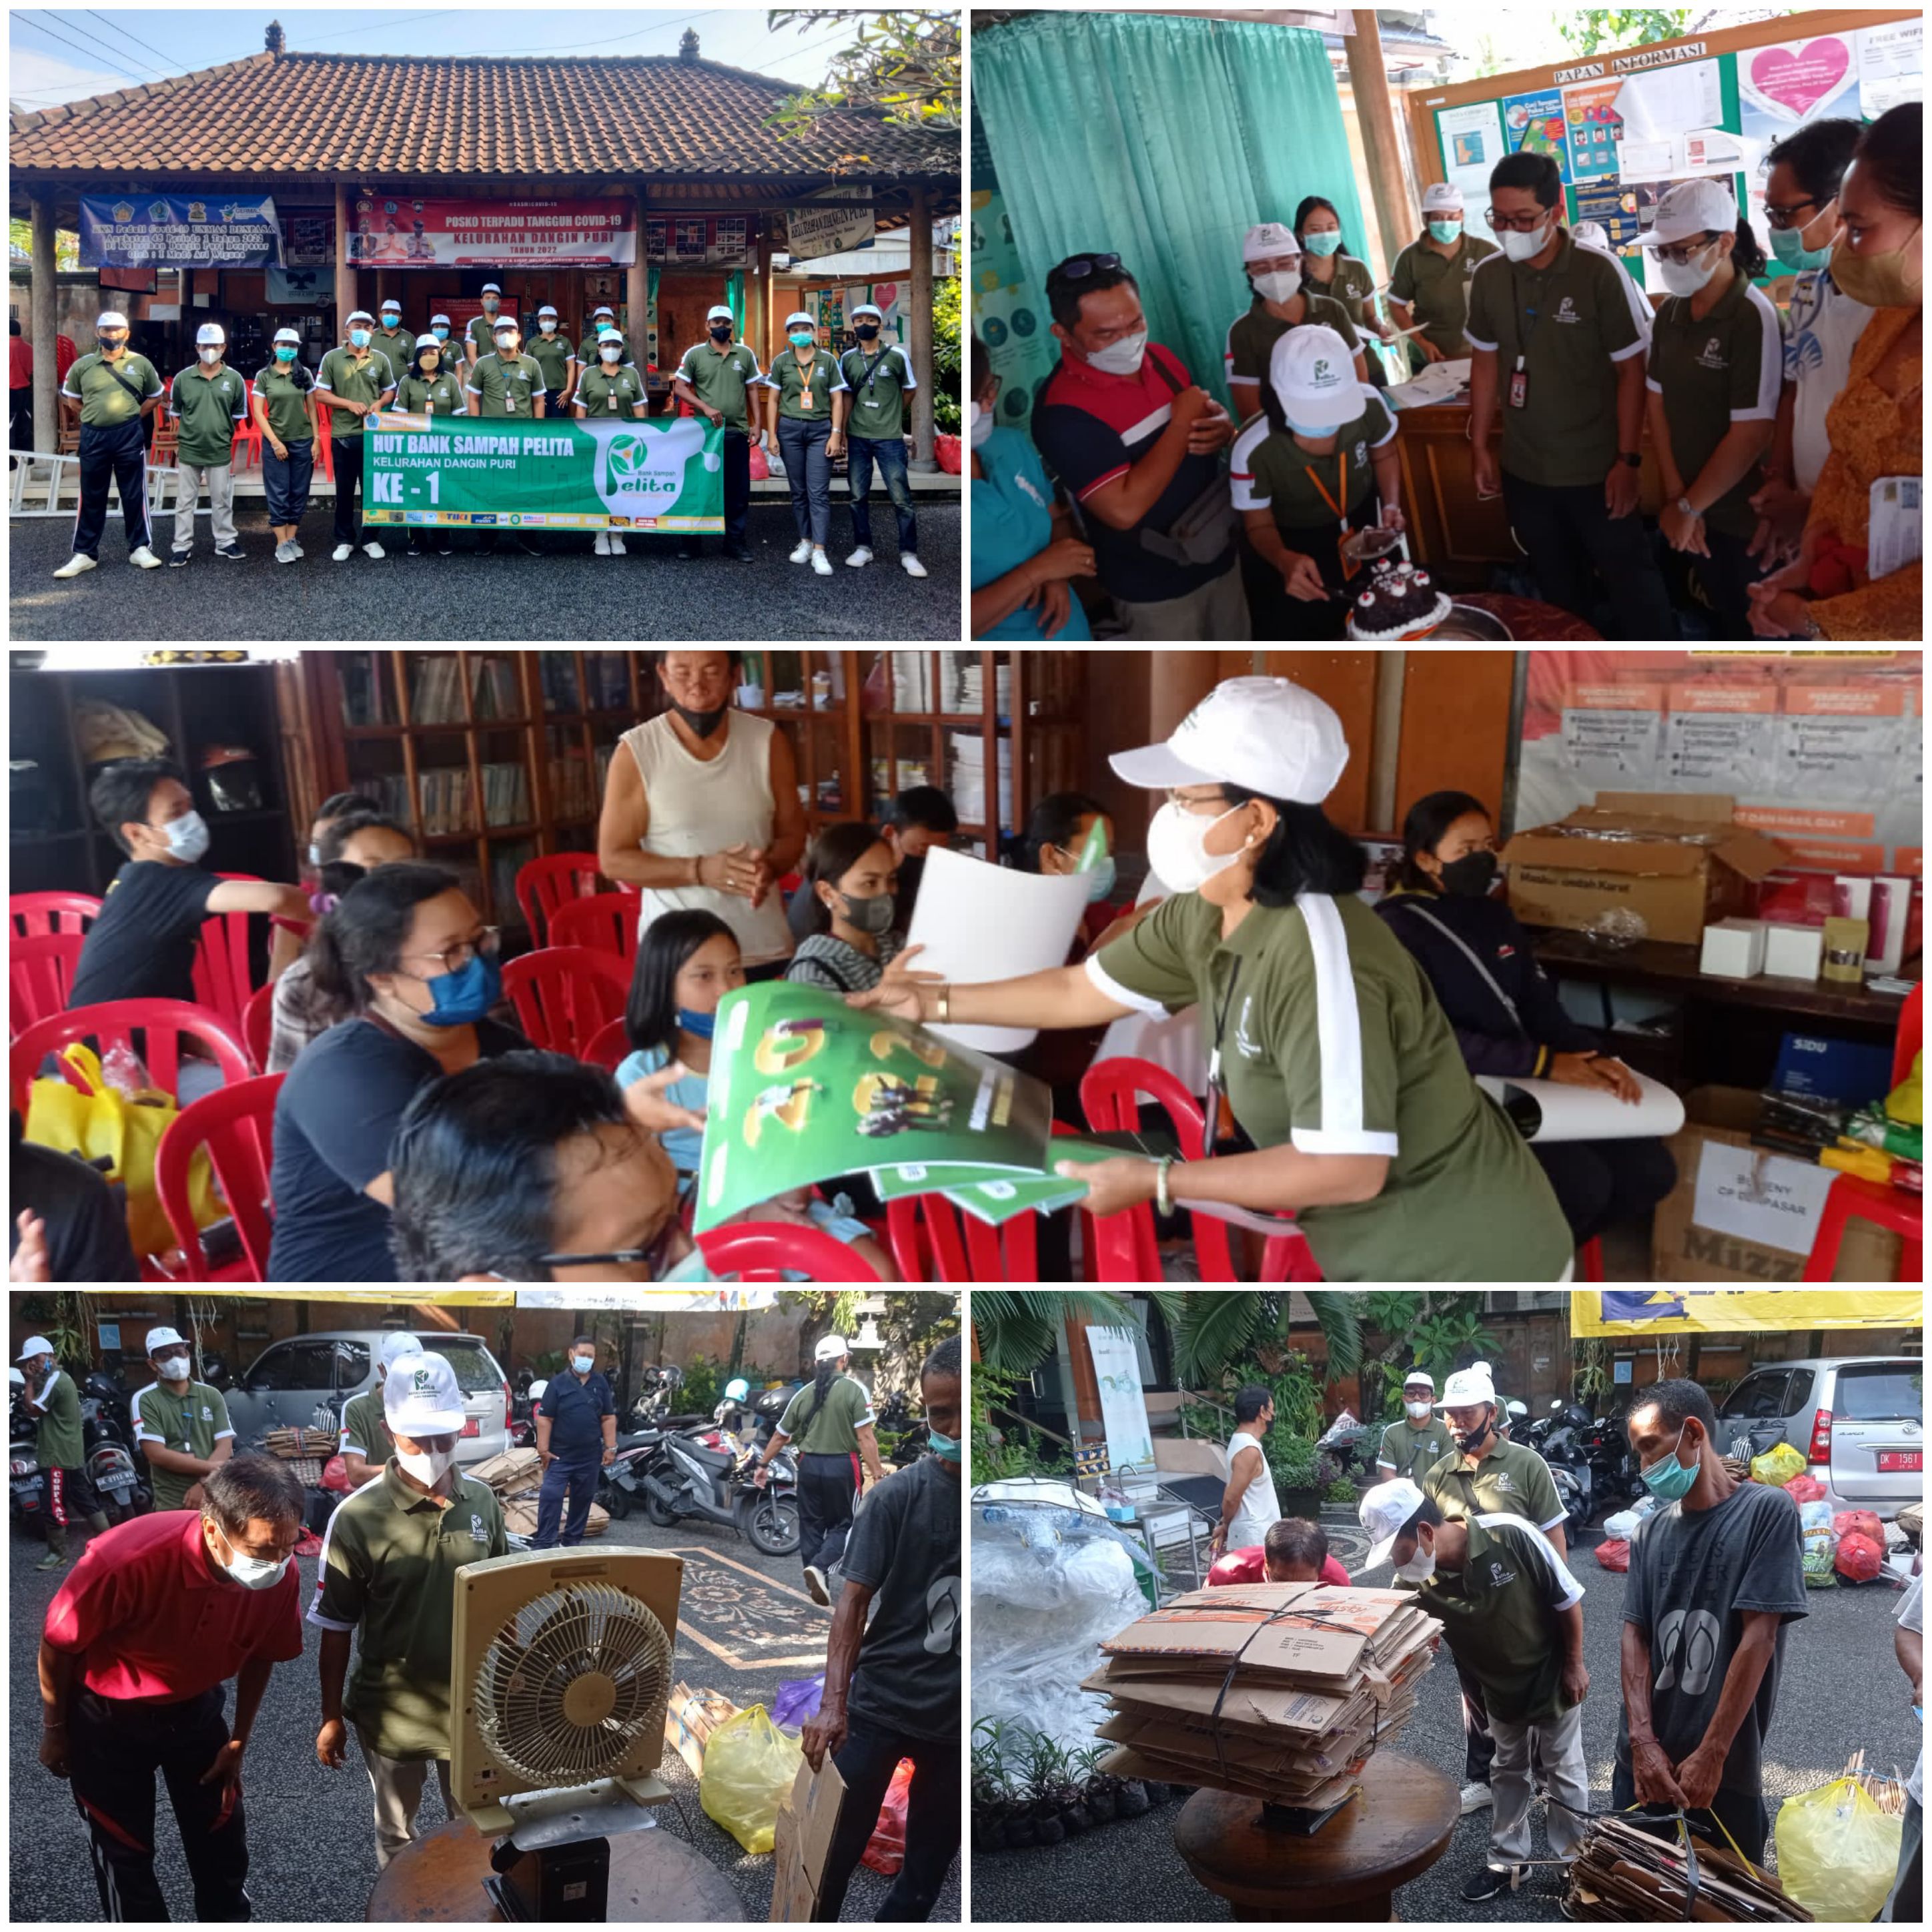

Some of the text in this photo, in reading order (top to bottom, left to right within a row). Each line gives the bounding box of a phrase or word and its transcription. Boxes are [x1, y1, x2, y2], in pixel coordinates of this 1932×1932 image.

[1869, 27, 1923, 44] FREE WIFI
[1554, 43, 1705, 83] PAPAN INFORMASI
[446, 214, 622, 227] POSKO TERPADU TANGGUH COVID-19
[116, 225, 146, 233] Peduli
[149, 225, 189, 233] Covid-19
[191, 225, 227, 233] UNMAS
[229, 225, 276, 233] DENPASA
[106, 234, 150, 243] Angkatan
[166, 234, 201, 242] Periode
[203, 234, 209, 242] 1
[211, 234, 240, 242] Tahun
[242, 233, 264, 242] 2022
[454, 231, 614, 244] KELURAHAN DANGIN PURI
[118, 242, 166, 250] Kelurahan
[169, 242, 201, 251] Dangin
[203, 242, 224, 250] Puri
[226, 242, 269, 252] Denpasar
[127, 250, 149, 258] Oleh
[167, 251, 192, 259] Made
[193, 251, 209, 259] Ari
[211, 251, 246, 260] Wiguna
[373, 434, 574, 456] HUT BANK SAMPAH PELITA
[373, 456, 516, 469] KELURAHAN DANGIN PURI
[654, 470, 676, 479] Sampah
[372, 472, 404, 504] KE
[425, 471, 440, 505] 1
[1879, 1453, 1917, 1464] DK 1561
[53, 1470, 61, 1504] CORPS
[1317, 1600, 1368, 1614] Tasty
